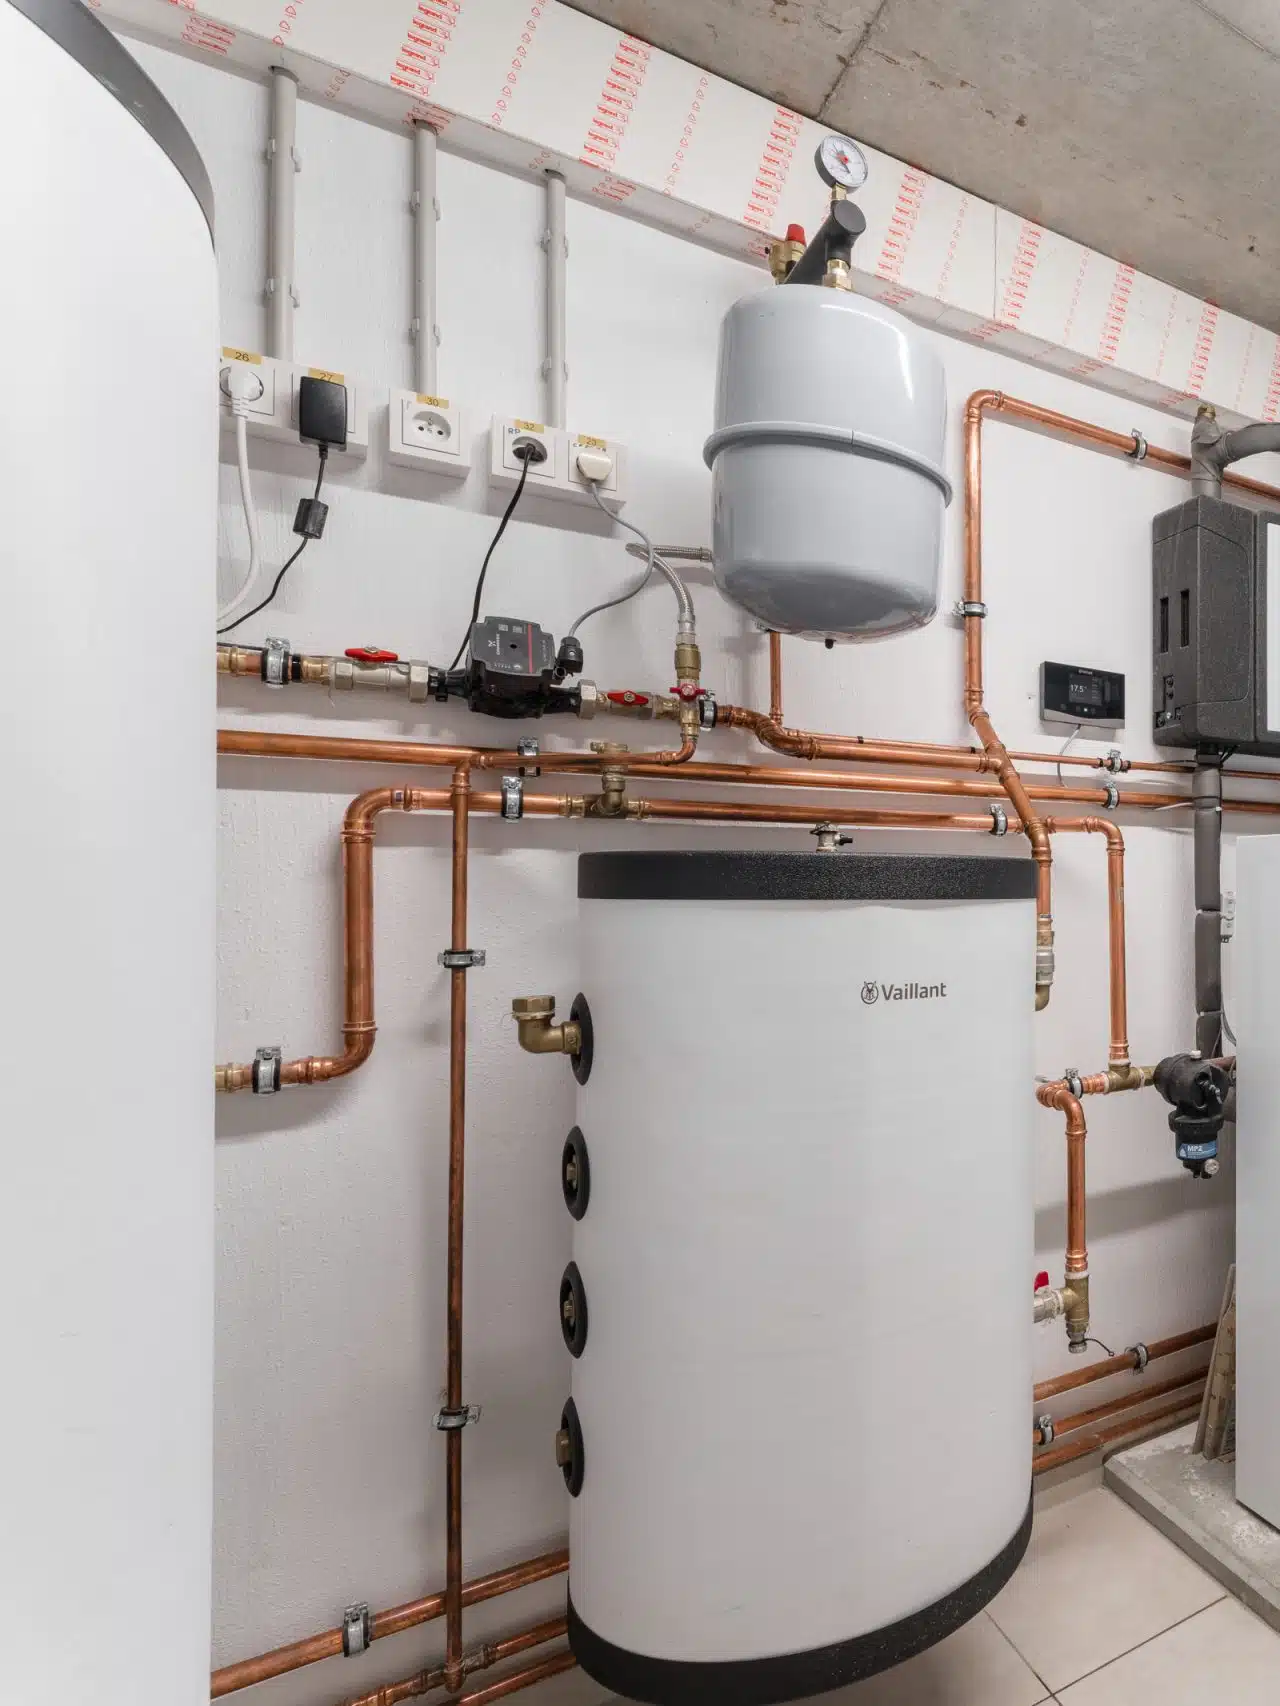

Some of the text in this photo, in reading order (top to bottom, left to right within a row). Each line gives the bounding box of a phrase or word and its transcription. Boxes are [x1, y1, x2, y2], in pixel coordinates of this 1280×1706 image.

[235, 351, 250, 363] 26
[319, 372, 333, 382] 27
[427, 397, 439, 407] 30
[523, 422, 535, 431] 32
[881, 982, 947, 1001] Vaillant
